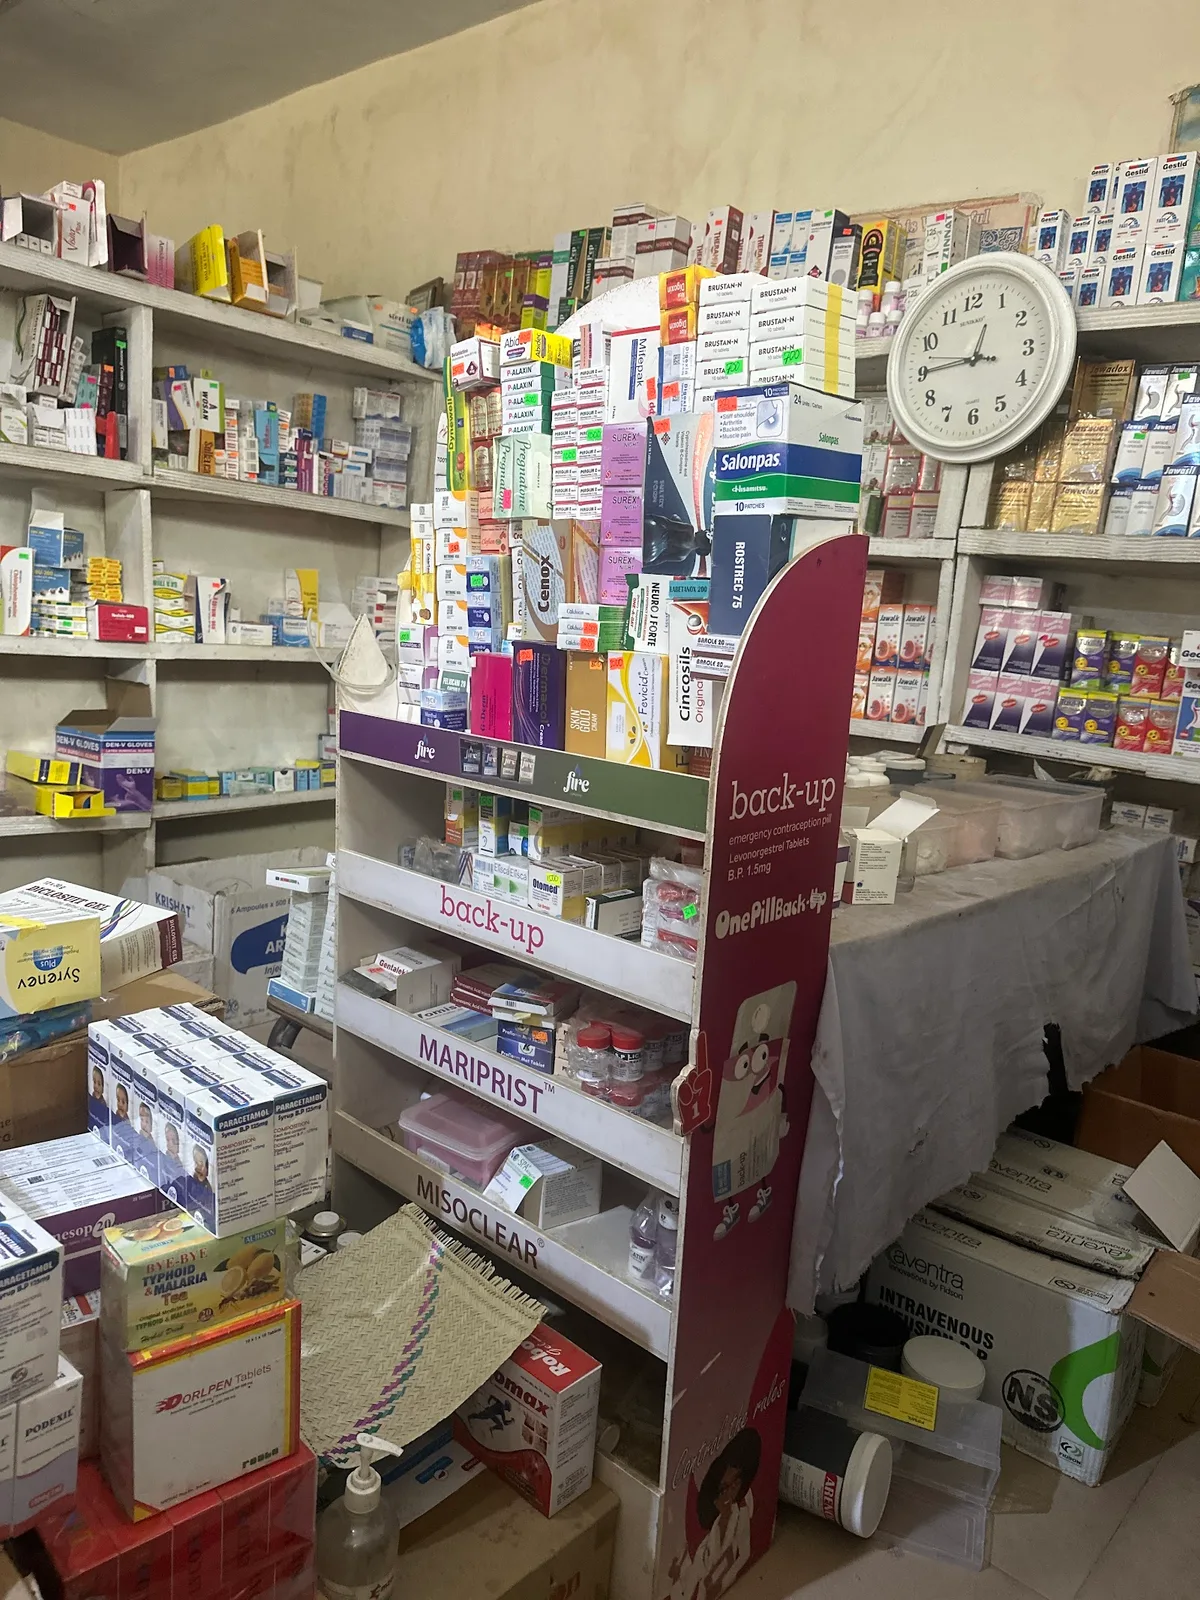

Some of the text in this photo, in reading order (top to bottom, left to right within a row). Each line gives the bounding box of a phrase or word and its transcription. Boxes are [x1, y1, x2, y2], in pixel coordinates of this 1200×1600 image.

[1091, 168, 1109, 176] Gestid
[1125, 167, 1149, 177] Gestid
[1163, 160, 1188, 171] Gestid
[1072, 220, 1091, 228] Gestid
[1112, 252, 1137, 261] Gestid
[1150, 248, 1176, 257] Gestid
[1081, 271, 1101, 279] Gestid
[708, 281, 743, 292] BRUSTAN-N
[760, 286, 797, 298] BRUSTAN-N
[963, 292, 983, 312] 12
[998, 293, 1006, 310] 1
[706, 310, 741, 320] BRUSTAN-N
[758, 316, 795, 328] BRUSTAN-N
[942, 308, 957, 326] 11
[1015, 310, 1028, 328] 2
[704, 338, 739, 348] BRUSTAN-N
[758, 343, 795, 355] BRUSTAN-N
[922, 333, 939, 352] 10
[1022, 338, 1035, 356] 3
[507, 366, 533, 376] P-ALAXIN
[636, 338, 648, 387] Mitepak
[703, 367, 725, 376] BRUSTA
[917, 365, 928, 383] 9
[1015, 369, 1027, 387] 4
[508, 382, 533, 391] P-ALAXIN
[764, 388, 772, 397] 10
[794, 395, 801, 405] 24
[925, 390, 936, 407] 8
[994, 394, 1006, 412] 5
[509, 411, 534, 419] P-ALAXIN
[734, 411, 755, 419] shoulder
[941, 405, 952, 423] 7
[967, 408, 979, 425] 6
[508, 426, 533, 434] P-ALAXIN
[612, 432, 637, 442] SUREX
[722, 425, 747, 433] Backache
[818, 432, 839, 445] Salonpas
[721, 453, 780, 472] Salonpas
[1164, 466, 1196, 475] Jawasil
[516, 439, 531, 511] Pregnatone
[612, 496, 637, 505] SUREX
[735, 502, 744, 512] 10
[608, 556, 633, 564] SUREX
[538, 555, 554, 613] Cenox
[732, 542, 746, 609] ROSTREC 75
[651, 582, 660, 612] NEURO
[697, 585, 708, 593] 200
[879, 614, 900, 623] Jawalk
[905, 614, 926, 623] Jawalk
[648, 621, 658, 647] FORTE
[541, 653, 551, 724] Dermacol
[679, 646, 691, 721] Cincosils
[871, 675, 892, 684] Jawalk
[897, 679, 918, 688] Jawalk
[638, 675, 648, 715] Fevicid
[695, 681, 706, 723] Origina
[571, 709, 580, 730] SKIN
[580, 709, 591, 733] GOLD
[56, 735, 99, 751] DEN-V GLOVES
[414, 740, 436, 760] fire
[126, 767, 151, 775] DEN-V
[563, 771, 590, 793] fire
[729, 773, 836, 820] back-up
[729, 813, 833, 846] emergency contraception pill
[729, 836, 810, 864] Levonorgestrel Tablets
[727, 861, 772, 882] B.P. 1.5mg
[533, 878, 557, 895] Otomed
[236, 903, 269, 914] Ampoules
[440, 885, 545, 954] back-up
[40, 958, 57, 968] Plus
[17, 967, 81, 990] Syrenev
[275, 1093, 323, 1112] PARACETAMOL
[691, 1104, 700, 1119] 1
[219, 1109, 269, 1129] PARACETAMOL
[278, 1111, 294, 1121] Syrup
[221, 1129, 238, 1139] Syrup
[738, 1151, 748, 1189] back-up
[989, 1160, 1053, 1191] aventra
[97, 1218, 112, 1231] 20
[1045, 1229, 1123, 1257] aventra
[146, 1247, 208, 1274] BYE-BYE
[0, 1261, 53, 1288] ARACETAMOL
[142, 1264, 196, 1287] TYPHOID
[893, 1250, 964, 1291] aventra
[144, 1272, 208, 1296] & MALARIA
[929, 1280, 939, 1291] by
[939, 1284, 964, 1300] Fidson
[135, 1307, 198, 1330] TYPHOID MALARIA
[880, 1285, 994, 1350] INTRAVENOUS
[235, 1363, 272, 1384] Tablets
[1007, 1377, 1060, 1423] NS
[25, 1410, 74, 1438] PODEXIL
[672, 1373, 786, 1490] Control the rules
